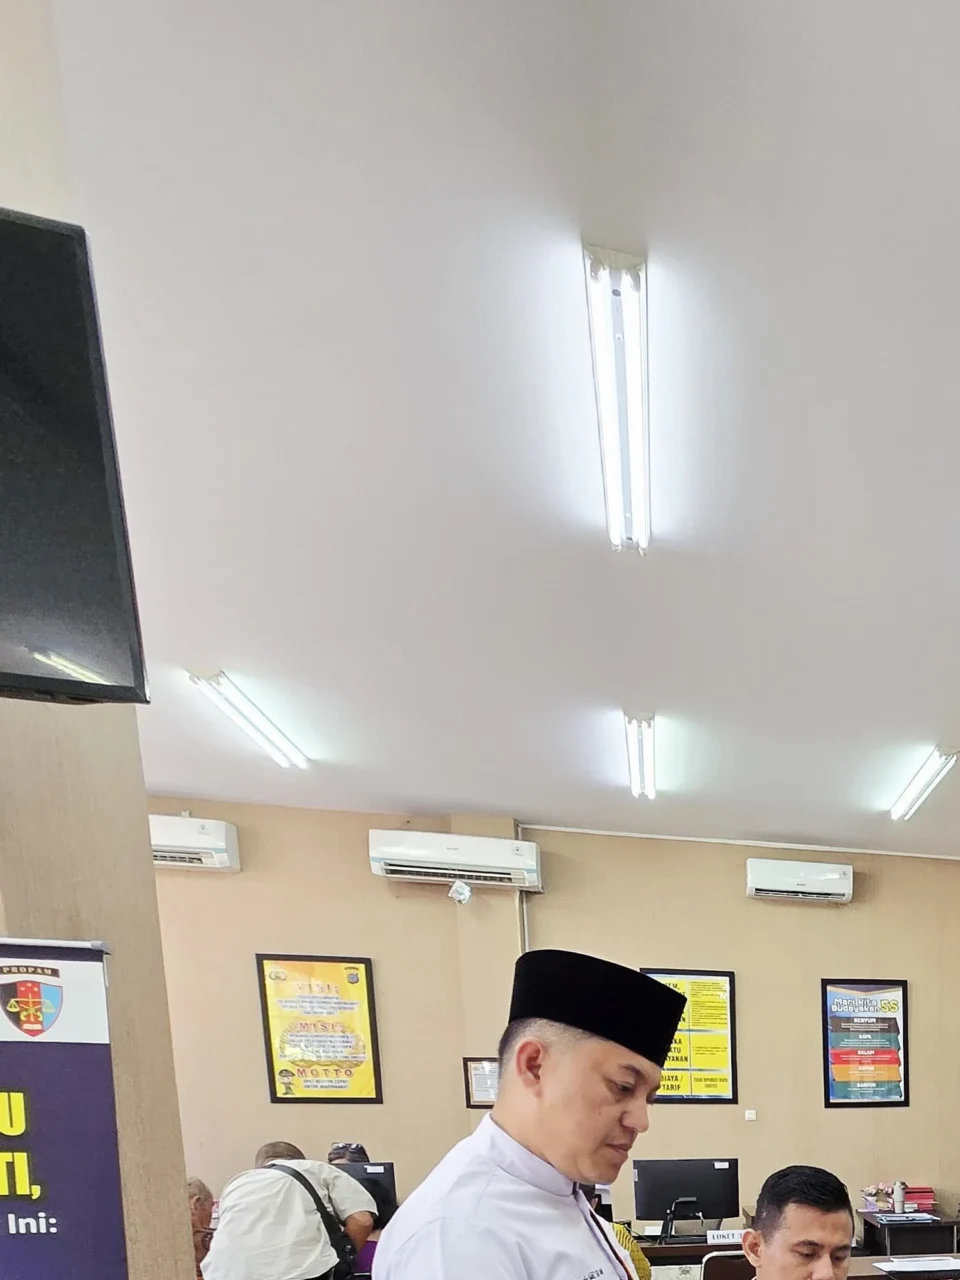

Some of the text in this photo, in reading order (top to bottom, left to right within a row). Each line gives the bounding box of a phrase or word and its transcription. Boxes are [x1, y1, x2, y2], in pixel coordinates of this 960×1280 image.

[2, 966, 52, 975] PROPAM
[297, 983, 340, 993] VISI:
[831, 999, 899, 1012] Budayakan 5S
[296, 1068, 353, 1077] MOTTO
[8, 1212, 58, 1234] Ini:
[712, 1233, 735, 1241] LOKET
